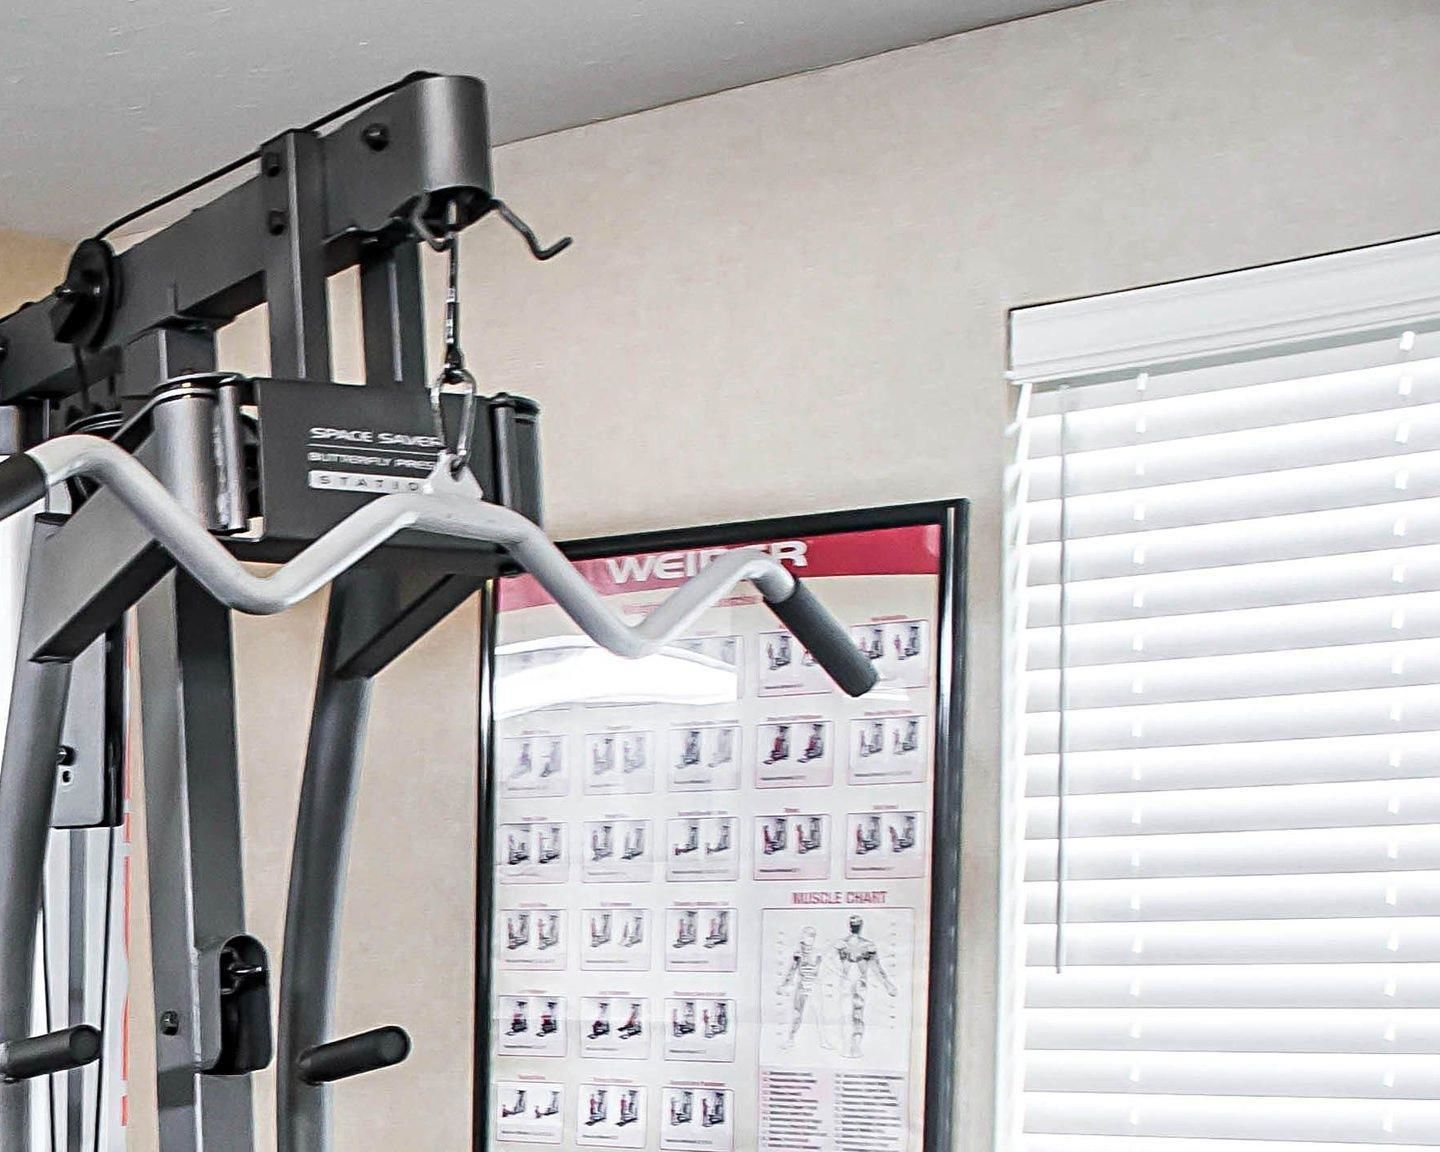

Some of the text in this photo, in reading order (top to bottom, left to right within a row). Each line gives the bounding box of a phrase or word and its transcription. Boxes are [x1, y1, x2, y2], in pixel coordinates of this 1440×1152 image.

[309, 427, 373, 442] SPACE
[307, 452, 435, 470] BUTTERFLY PRES
[319, 475, 419, 491] STATIO
[607, 541, 807, 584] WEIR
[793, 891, 887, 904] MUSCLE CHART
